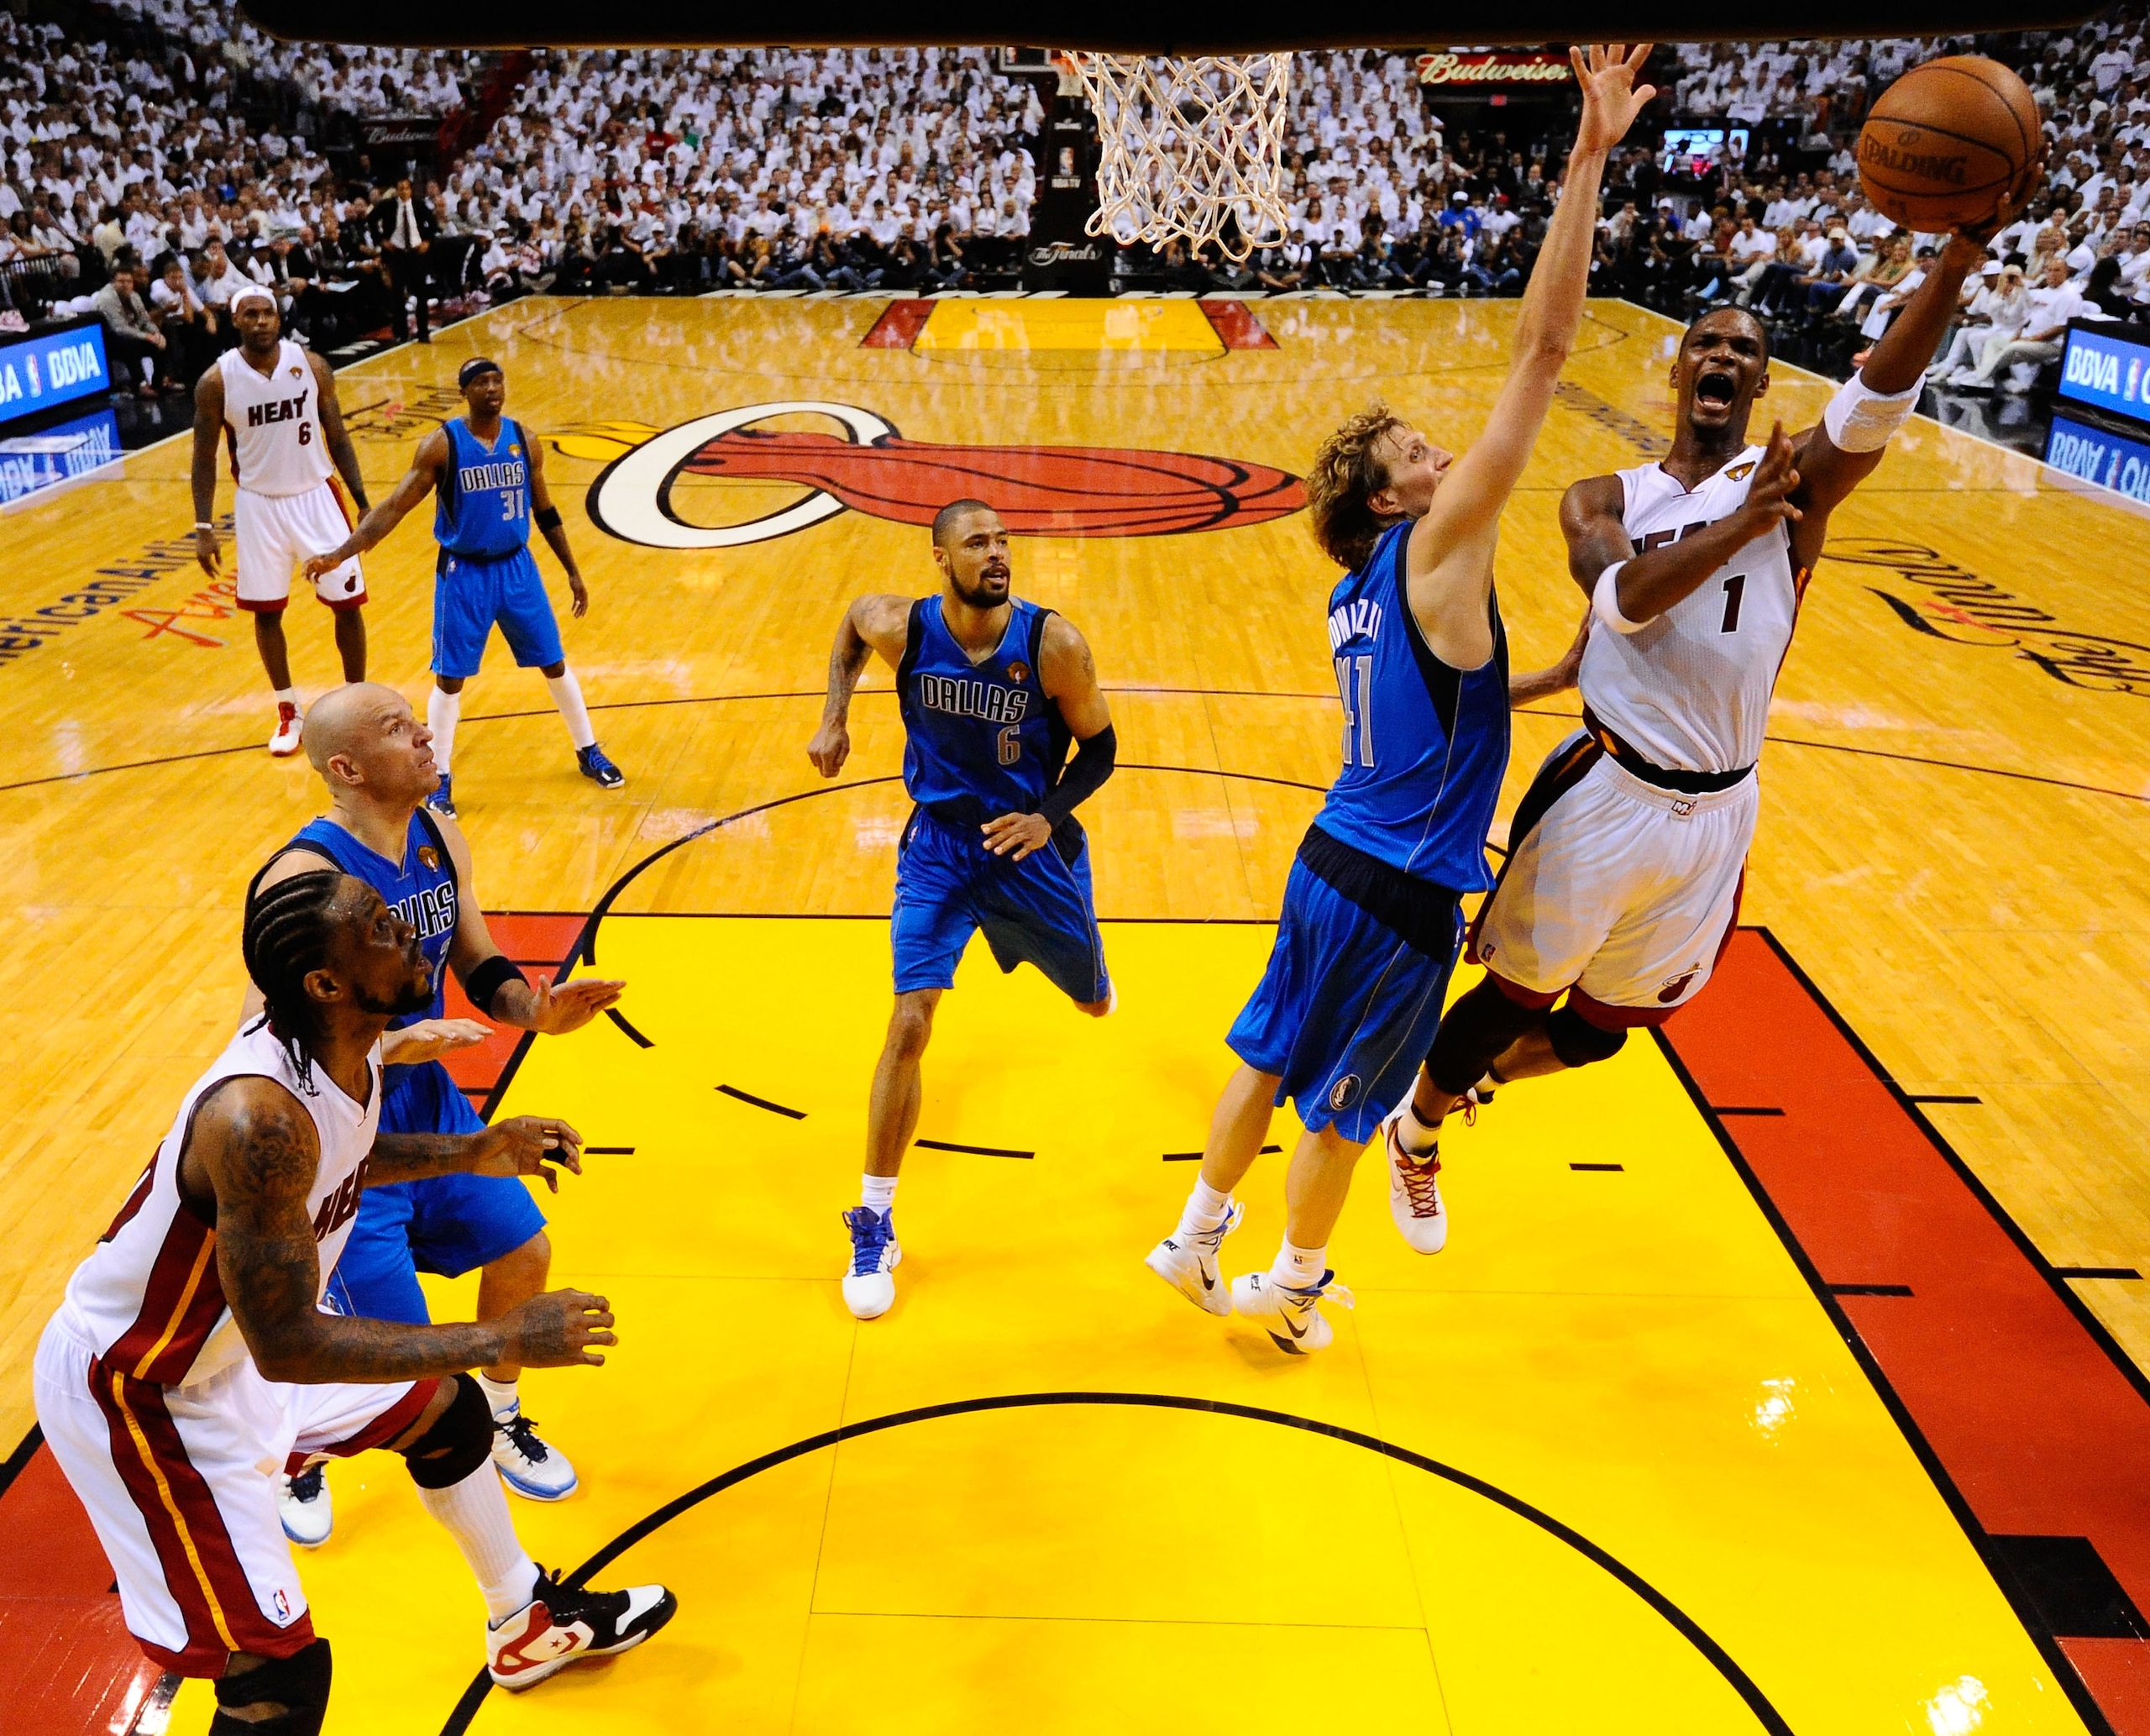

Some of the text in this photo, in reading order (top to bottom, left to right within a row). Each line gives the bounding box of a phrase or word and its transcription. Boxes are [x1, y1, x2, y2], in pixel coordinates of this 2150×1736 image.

[1862, 134, 1967, 185] SPALDING
[1047, 241, 1101, 263] Finals
[48, 341, 101, 389] BBVA
[2065, 344, 2119, 395] BBVA
[248, 388, 307, 427] HEAT
[298, 422, 312, 445] 6
[459, 460, 526, 494] DALLAS
[500, 488, 525, 522] 31
[1720, 565, 1747, 635] 1
[921, 674, 1030, 724] DALLAS
[1335, 655, 1375, 768] 41
[998, 723, 1020, 766] 6
